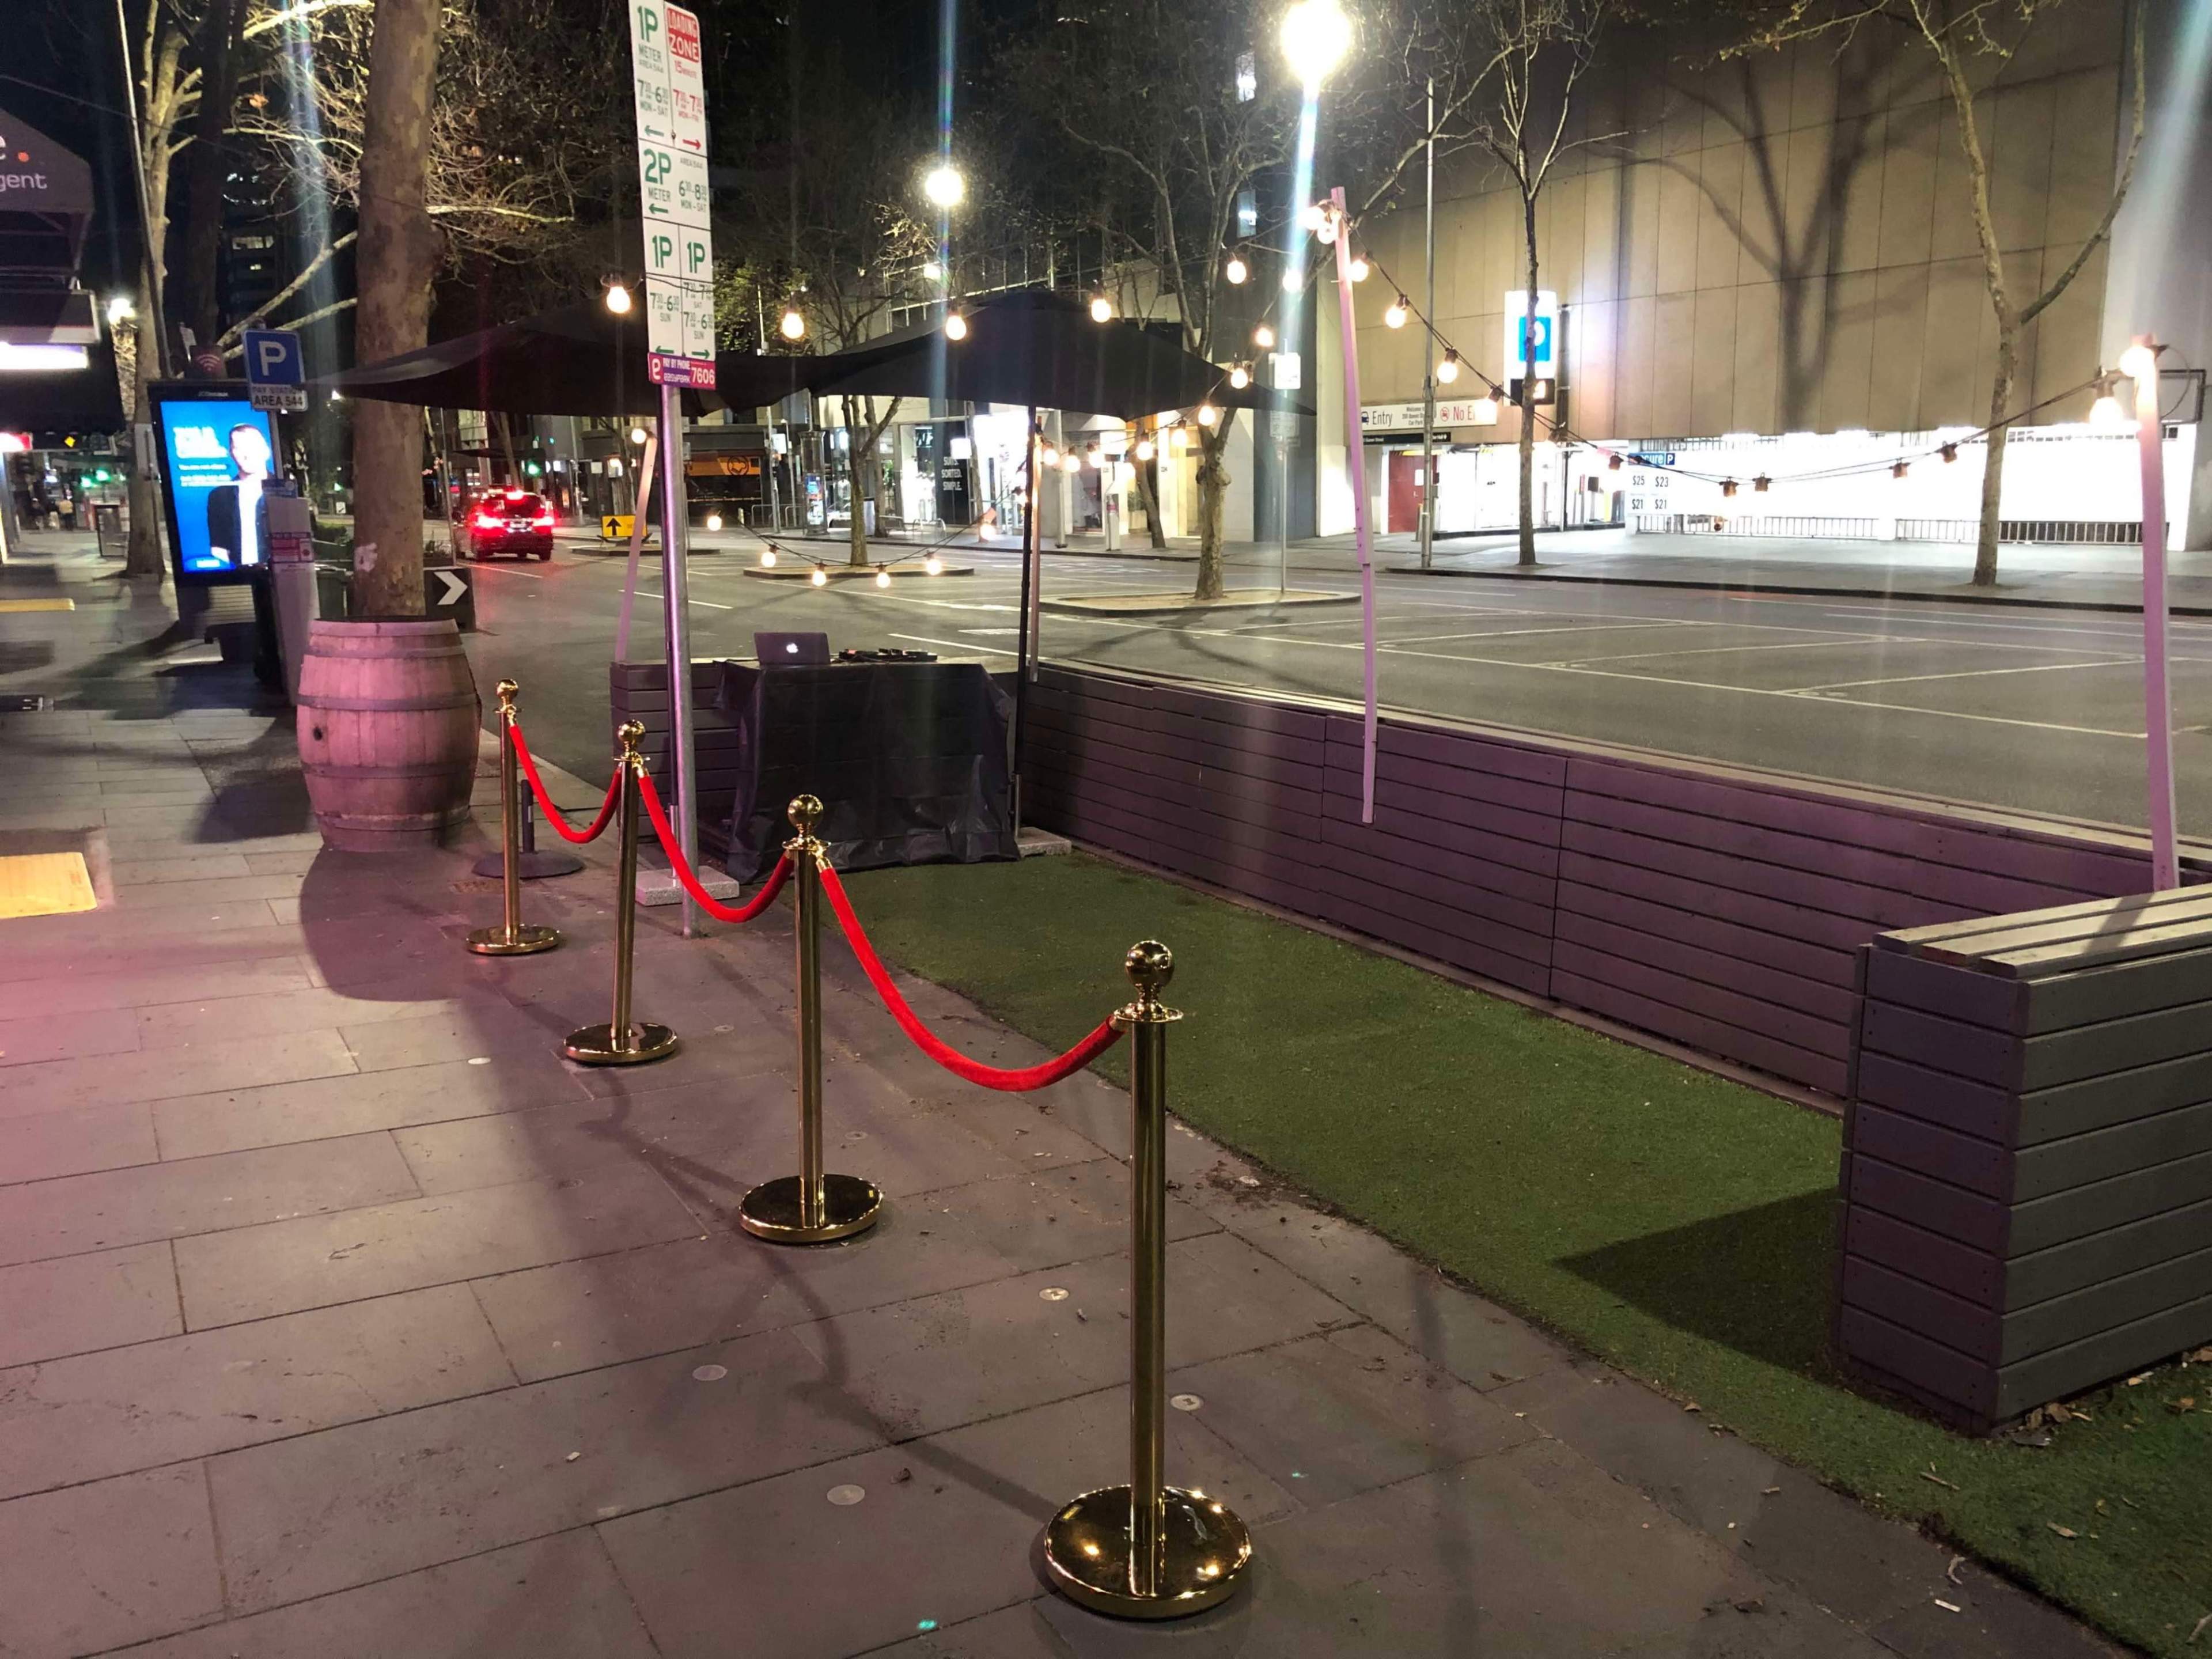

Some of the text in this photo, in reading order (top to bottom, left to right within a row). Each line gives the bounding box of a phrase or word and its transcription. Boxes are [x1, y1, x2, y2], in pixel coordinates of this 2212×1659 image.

[637, 5, 658, 43] 1P
[668, 10, 698, 37] LOADING
[638, 44, 662, 63] METER
[668, 33, 699, 60] ZONE
[643, 148, 671, 185] 2P
[647, 187, 671, 202] METER
[696, 203, 707, 213] SAT
[652, 235, 672, 268] 1P
[687, 241, 706, 274] 1P
[660, 313, 671, 322] SUN
[694, 331, 704, 340] SUN
[259, 341, 286, 376] P
[671, 359, 676, 369] BY
[677, 359, 691, 370] PHONE
[691, 367, 715, 385] 7606
[255, 396, 303, 406] AREA 544
[1372, 411, 1393, 427] Entry
[1453, 406, 1464, 421] No
[1632, 475, 1669, 487] $25 $23
[1631, 498, 1667, 510] $21 $21
